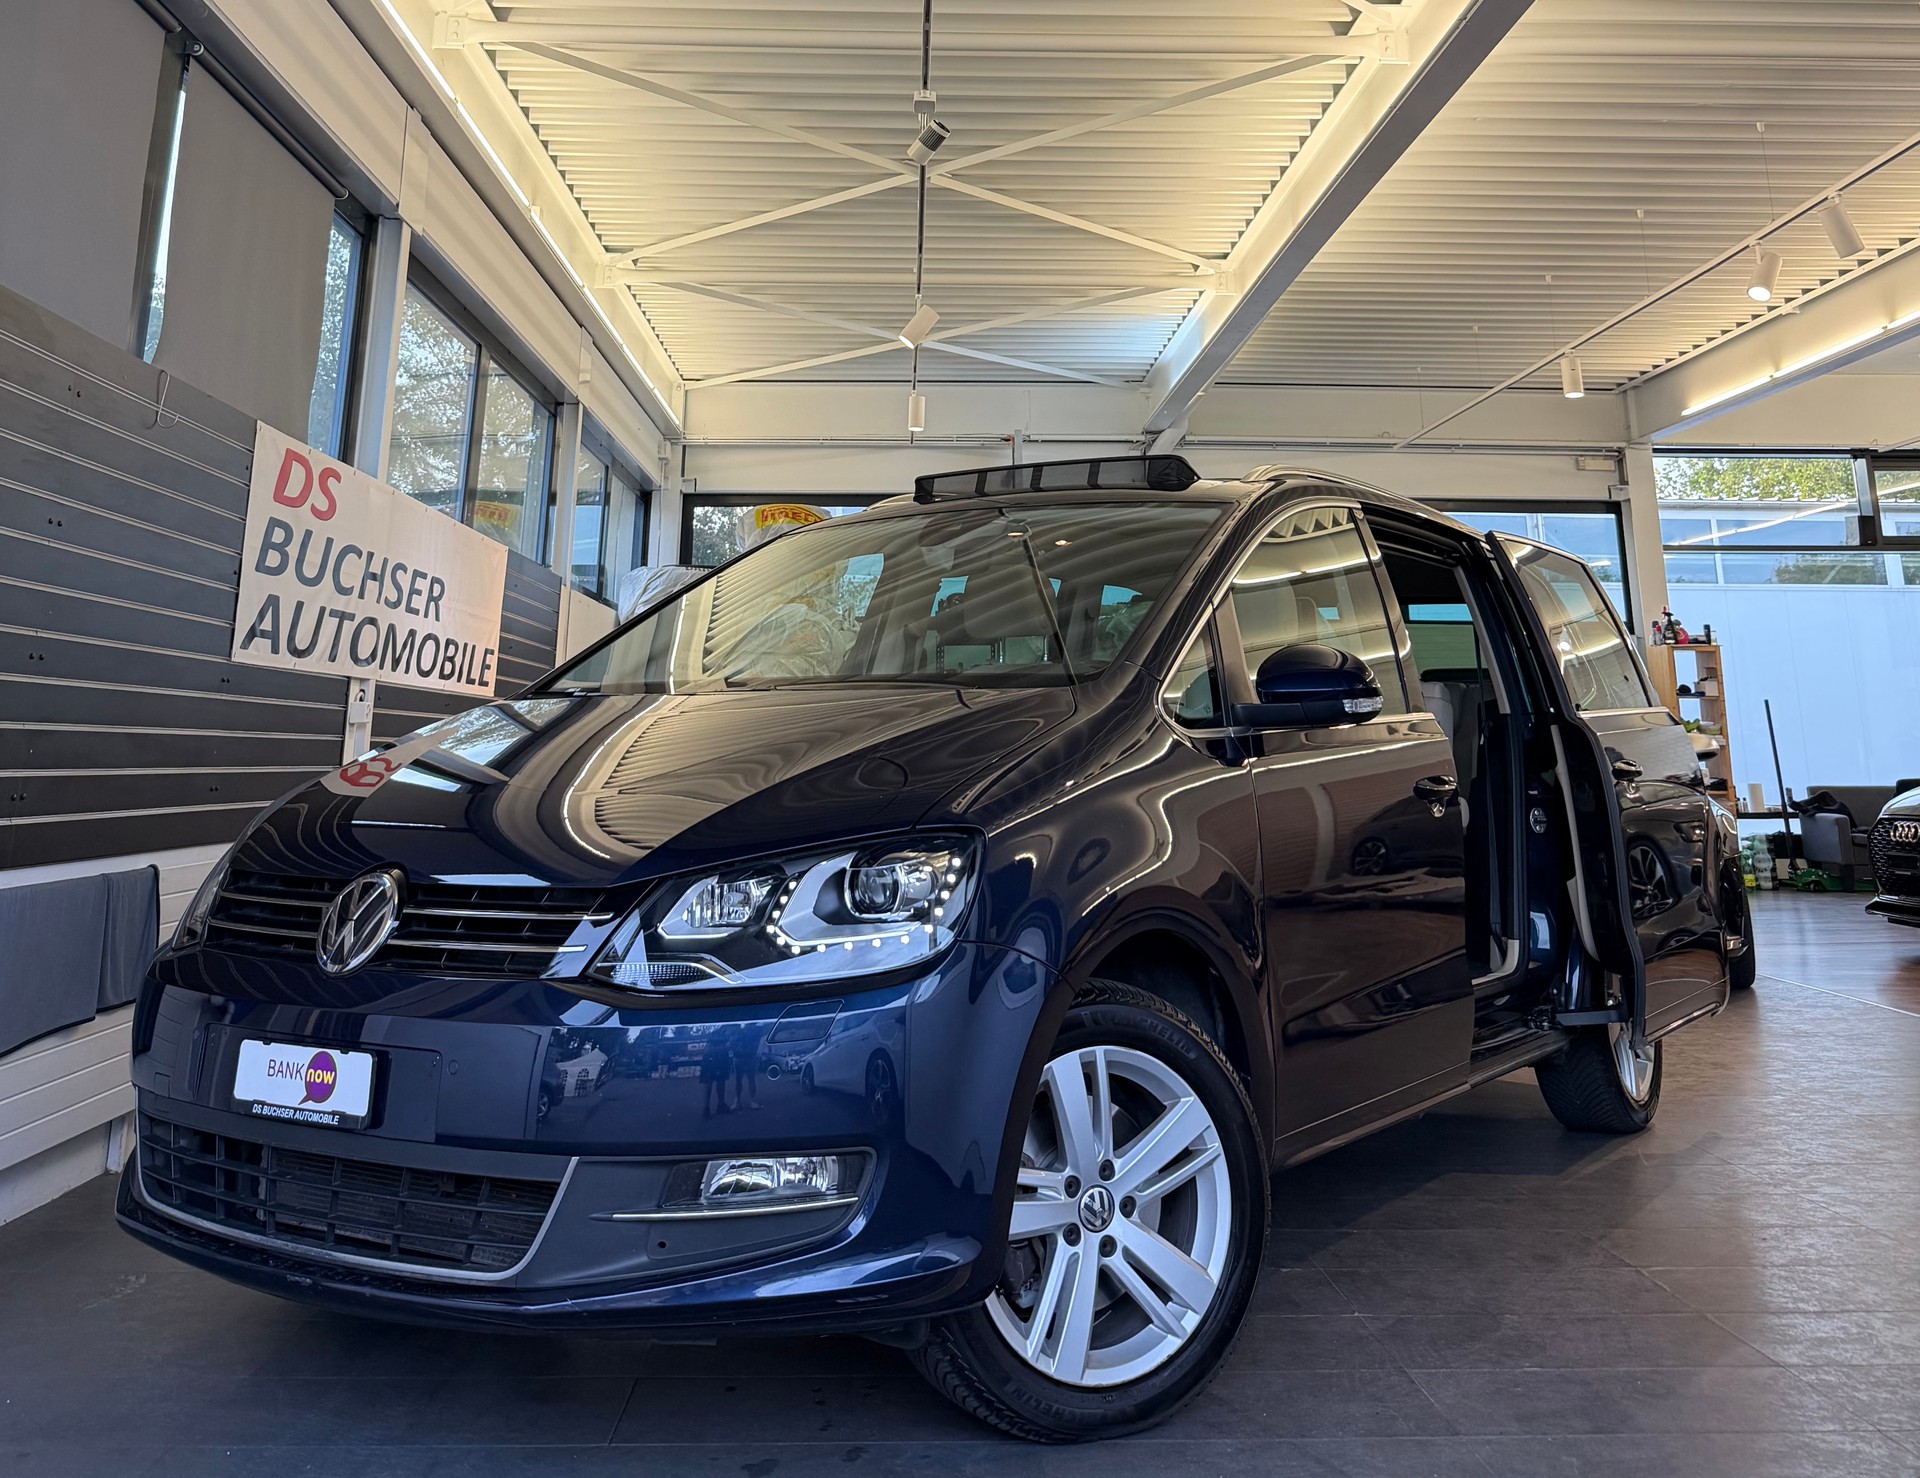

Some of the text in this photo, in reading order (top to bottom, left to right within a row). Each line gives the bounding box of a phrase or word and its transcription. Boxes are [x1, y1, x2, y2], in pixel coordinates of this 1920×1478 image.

[272, 447, 342, 521] DS
[255, 516, 446, 622] BUCHSER
[240, 593, 495, 687] AUTOMOBILE
[267, 1059, 335, 1084] BANK now
[252, 1104, 340, 1125] DS BUCHSER AUTOMOBILE
